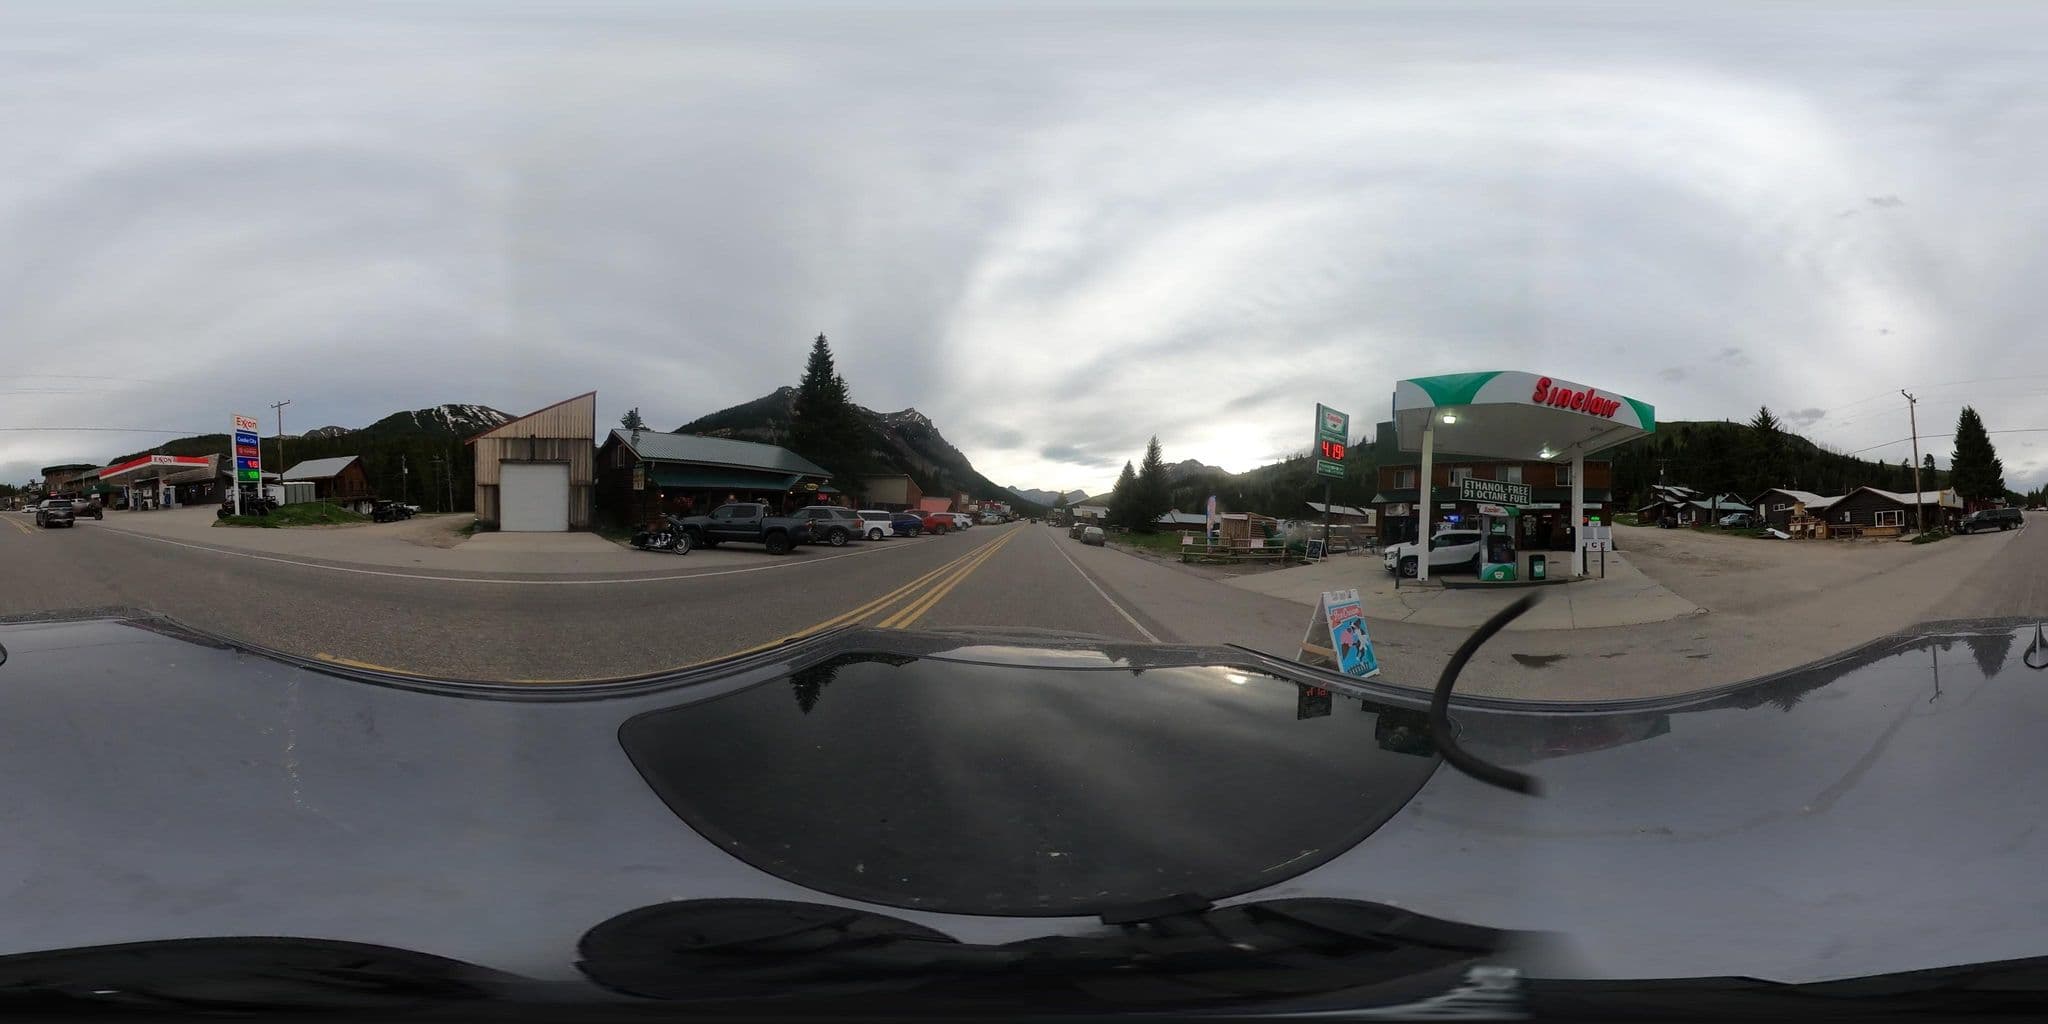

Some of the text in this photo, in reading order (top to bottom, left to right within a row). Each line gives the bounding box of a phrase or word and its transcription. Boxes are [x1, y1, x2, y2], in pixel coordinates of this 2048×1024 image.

[1532, 377, 1621, 418] Sinclair
[1465, 480, 1529, 495] ETHANOL-FREE
[1464, 489, 1529, 504] 91 OCTANE FUEL
